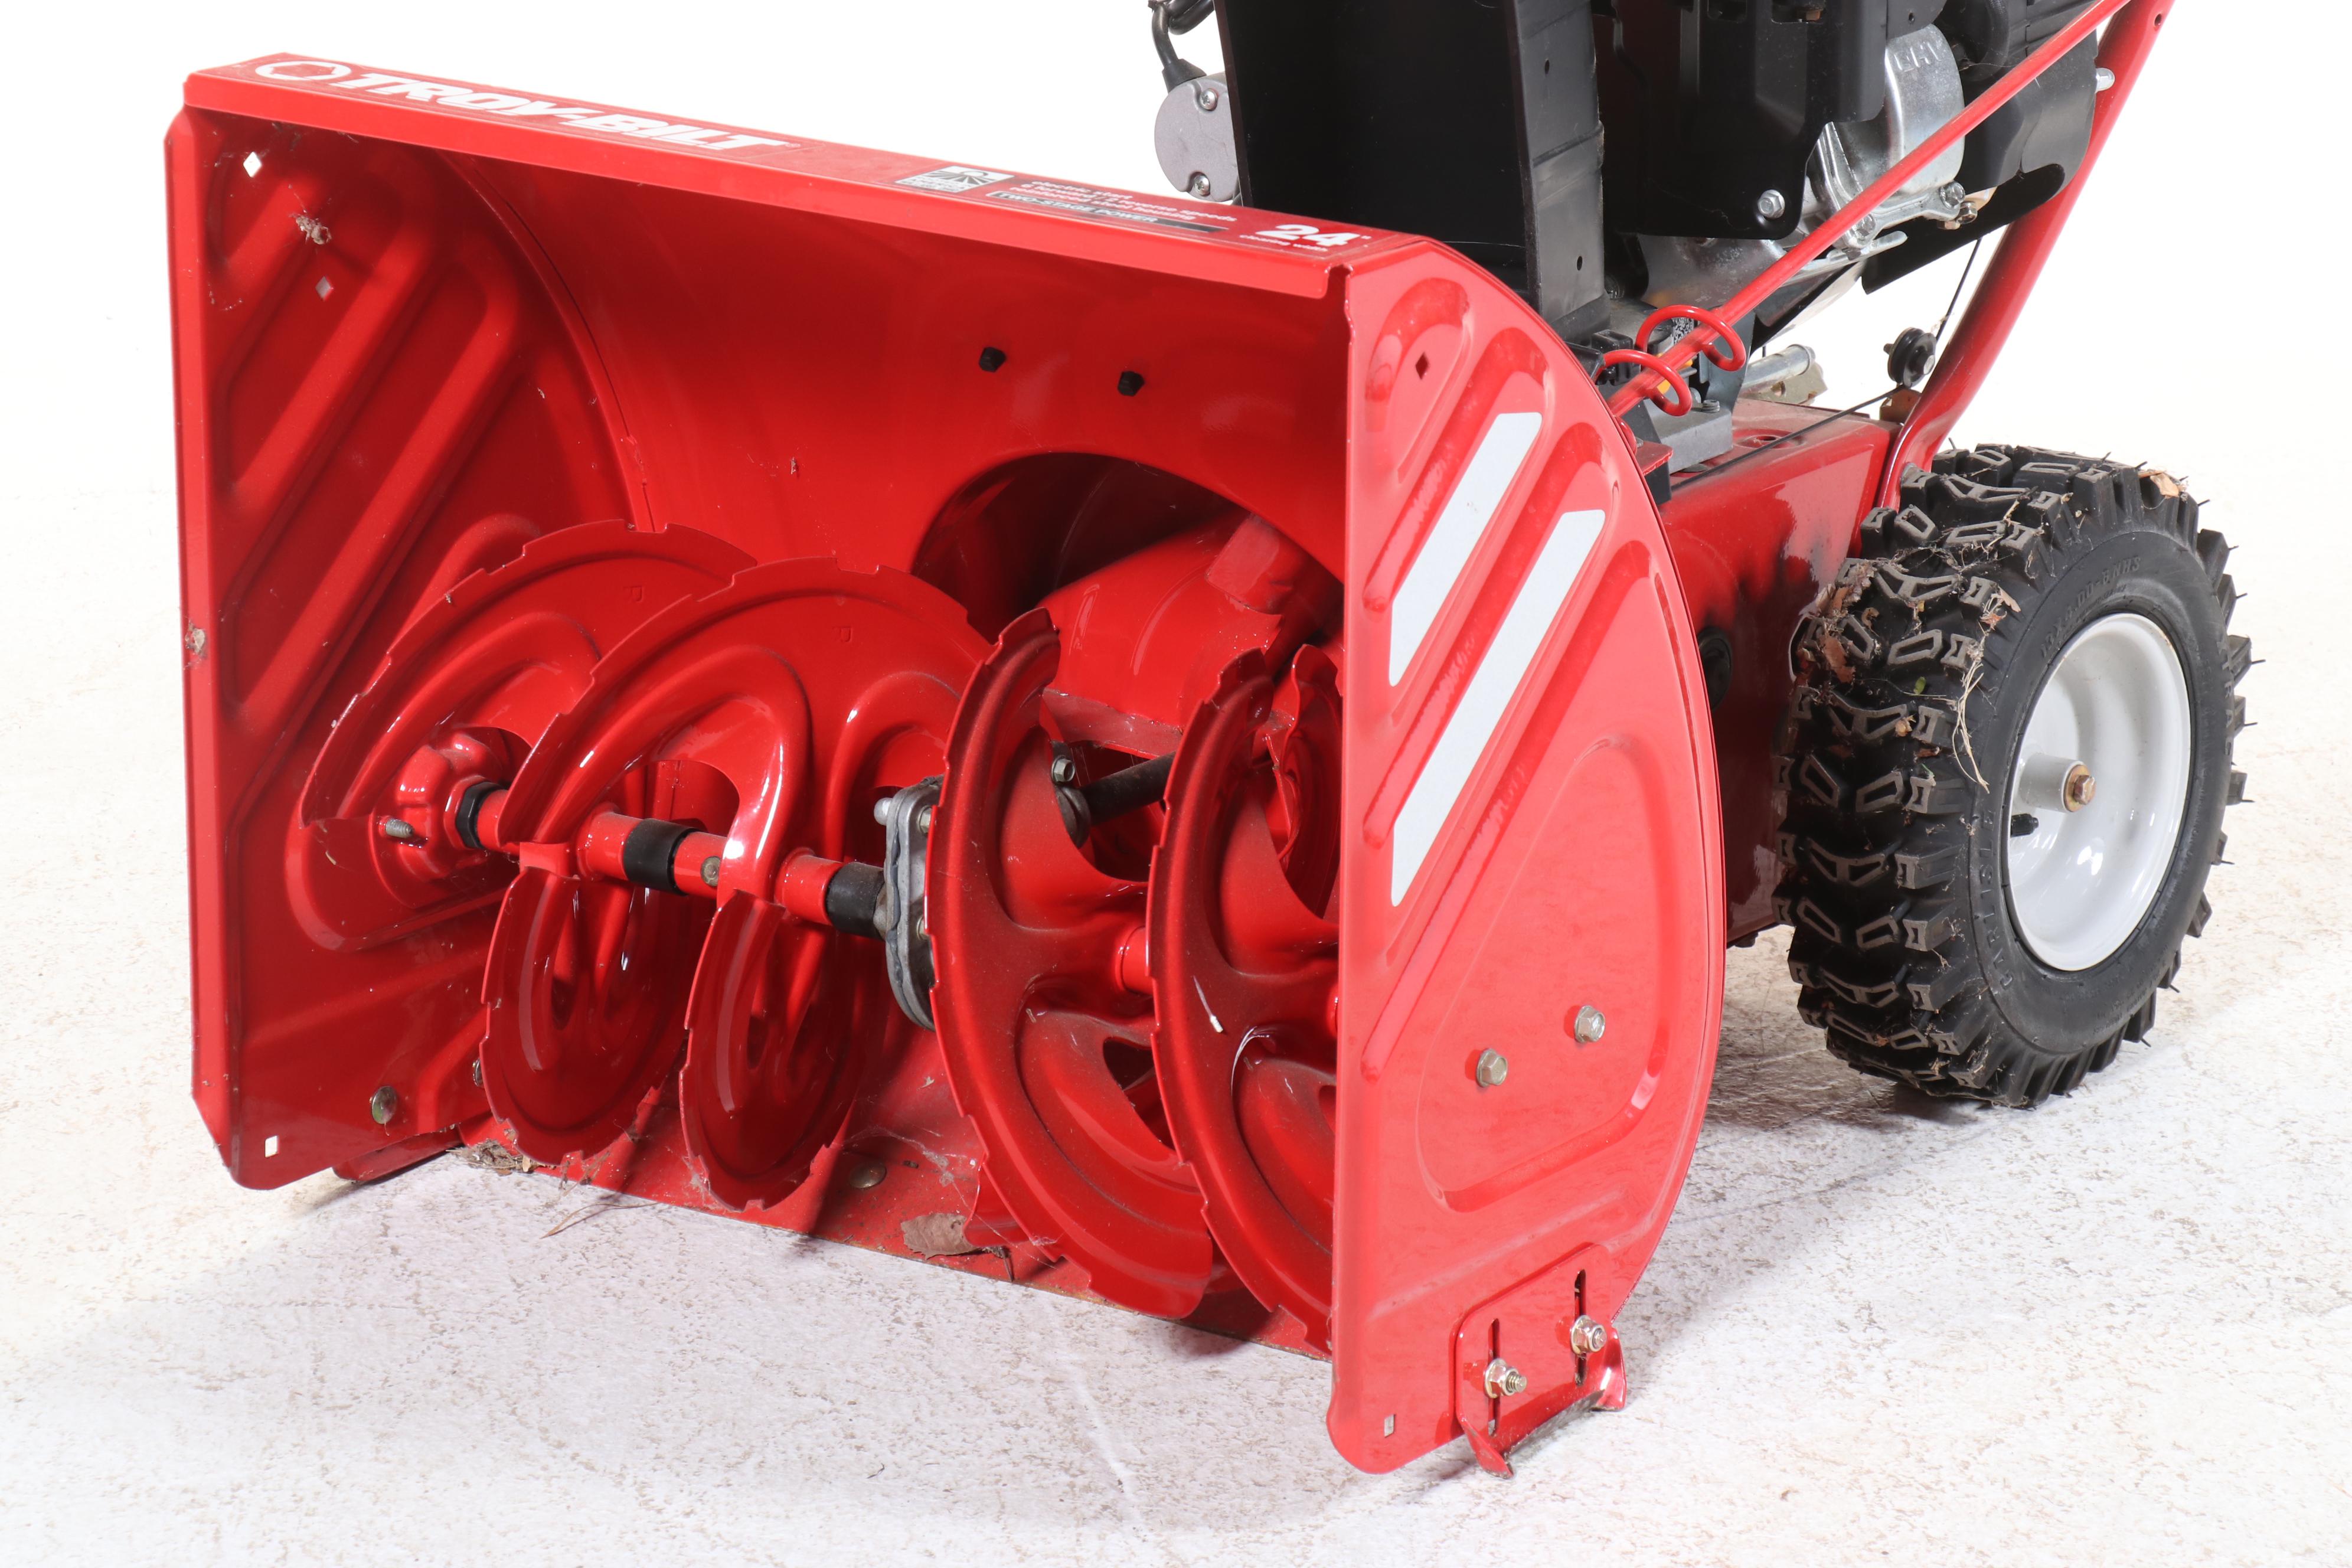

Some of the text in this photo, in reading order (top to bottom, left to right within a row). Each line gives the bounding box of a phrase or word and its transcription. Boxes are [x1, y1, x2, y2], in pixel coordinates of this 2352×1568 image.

[329, 73, 790, 150] TROY-BILT
[1093, 191, 1133, 200] start
[1000, 192, 1158, 222] TWO-STAGE POWER
[1091, 200, 1133, 209] steel
[1132, 207, 1197, 221] housing
[1119, 200, 1177, 211] reverse
[1180, 210, 1237, 222] speeds
[1239, 234, 1328, 252] clearing width
[1979, 810, 2013, 989] CARLISLE
